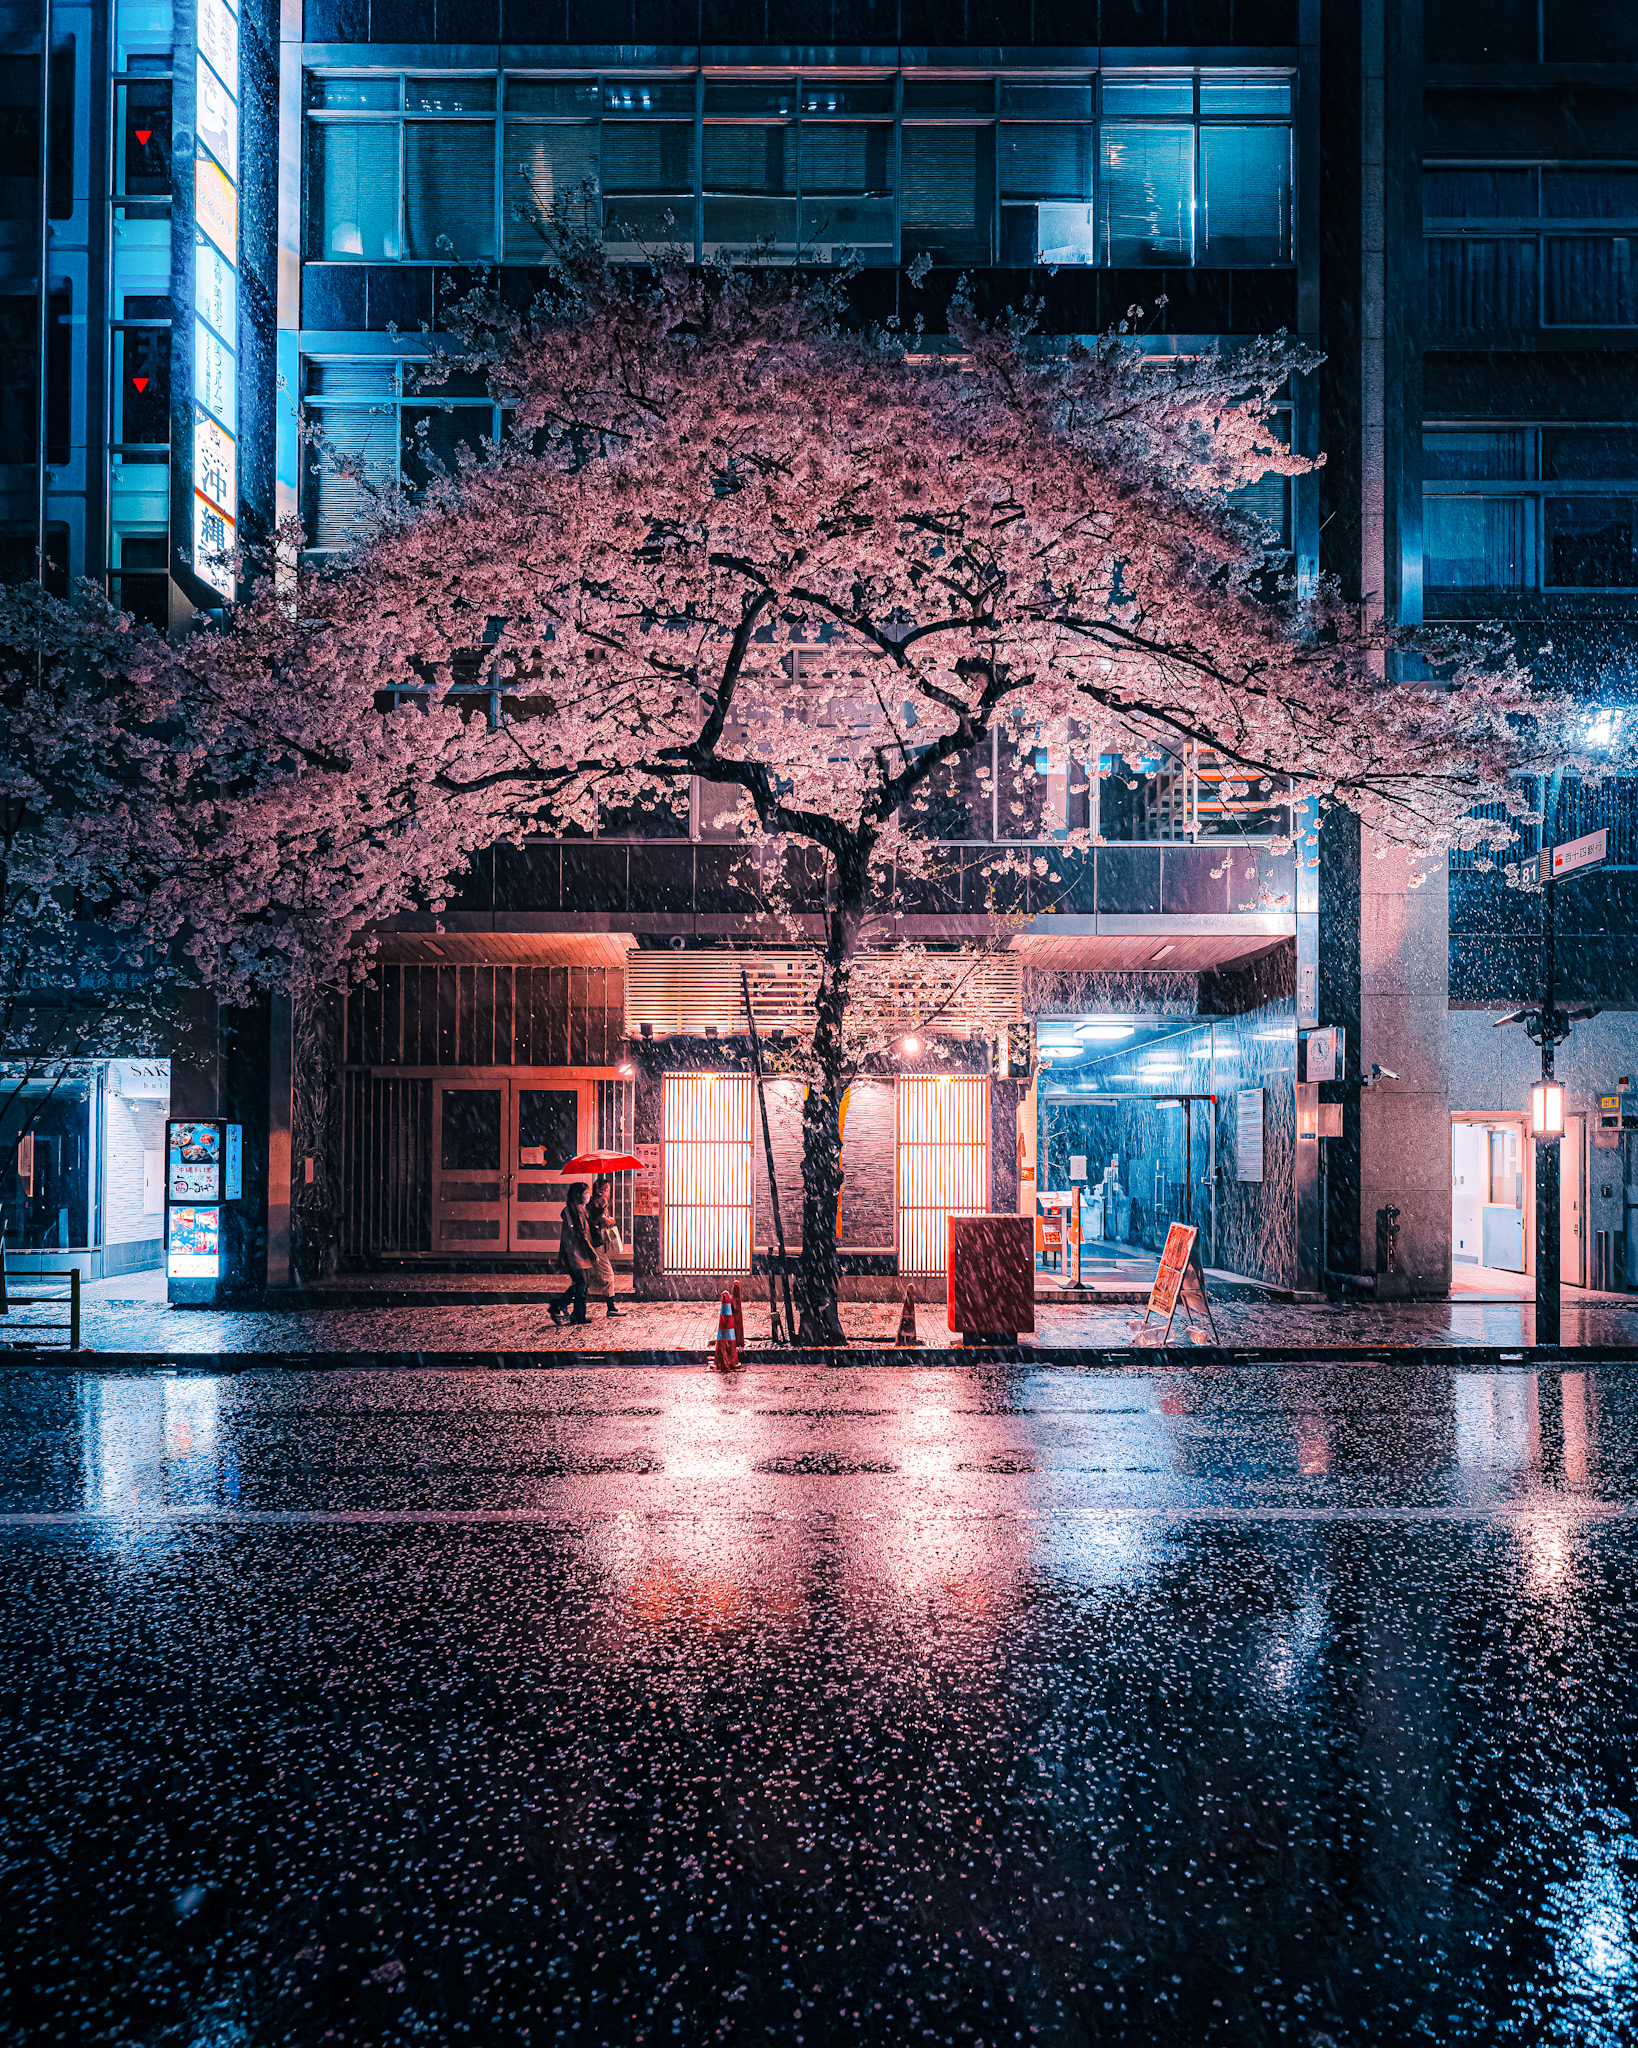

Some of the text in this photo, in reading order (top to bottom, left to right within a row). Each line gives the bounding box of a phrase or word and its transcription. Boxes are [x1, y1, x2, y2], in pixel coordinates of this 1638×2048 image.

[1565, 841, 1602, 863] 百十四銀行
[1522, 864, 1537, 883] 81
[130, 1065, 169, 1077] SAK
